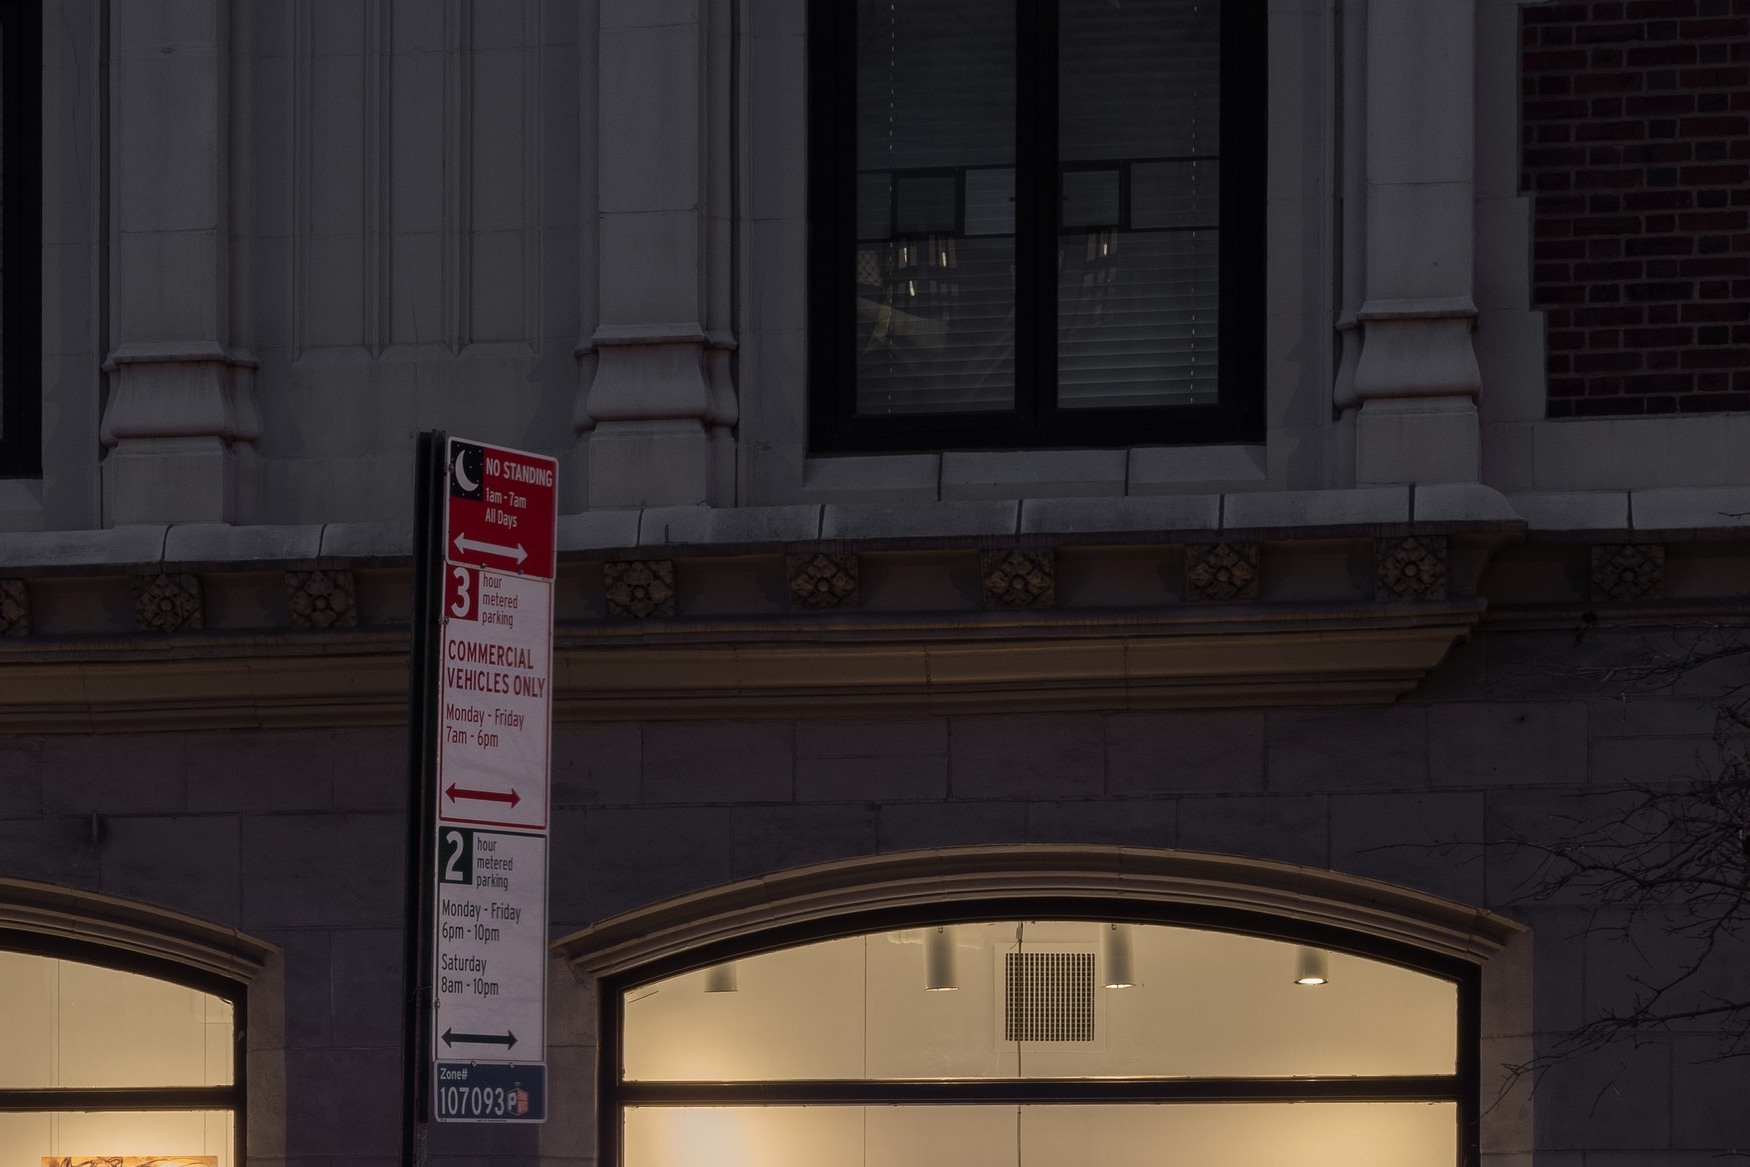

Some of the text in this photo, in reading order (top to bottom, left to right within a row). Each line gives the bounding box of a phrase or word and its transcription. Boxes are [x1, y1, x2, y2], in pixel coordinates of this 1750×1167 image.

[486, 457, 553, 487] NO STANDING
[486, 487, 502, 504] 1am
[509, 491, 527, 509] 7am
[485, 507, 518, 530] All Days
[451, 567, 470, 618] 3
[483, 573, 502, 590] hour
[482, 593, 518, 609] metered
[482, 611, 514, 629] parking
[448, 639, 534, 669] COMMERCIAL
[447, 667, 545, 698] VEHICLES ONLY
[446, 703, 485, 728] Monday
[495, 708, 524, 732] Friday
[446, 726, 467, 744] 7am
[477, 729, 498, 750] 6pm
[445, 830, 464, 881] 2
[477, 837, 497, 852] hour
[477, 857, 513, 871] metered
[477, 875, 508, 891] parking
[442, 899, 481, 922] Monday
[491, 902, 521, 924] Friday
[442, 922, 464, 943] 6pm
[474, 924, 499, 944] 10pm
[442, 953, 487, 976] Saturday
[441, 976, 463, 994] 8am
[473, 978, 499, 998] 10pm
[440, 1068, 468, 1080] Zone#
[440, 1087, 505, 1115] 107093
